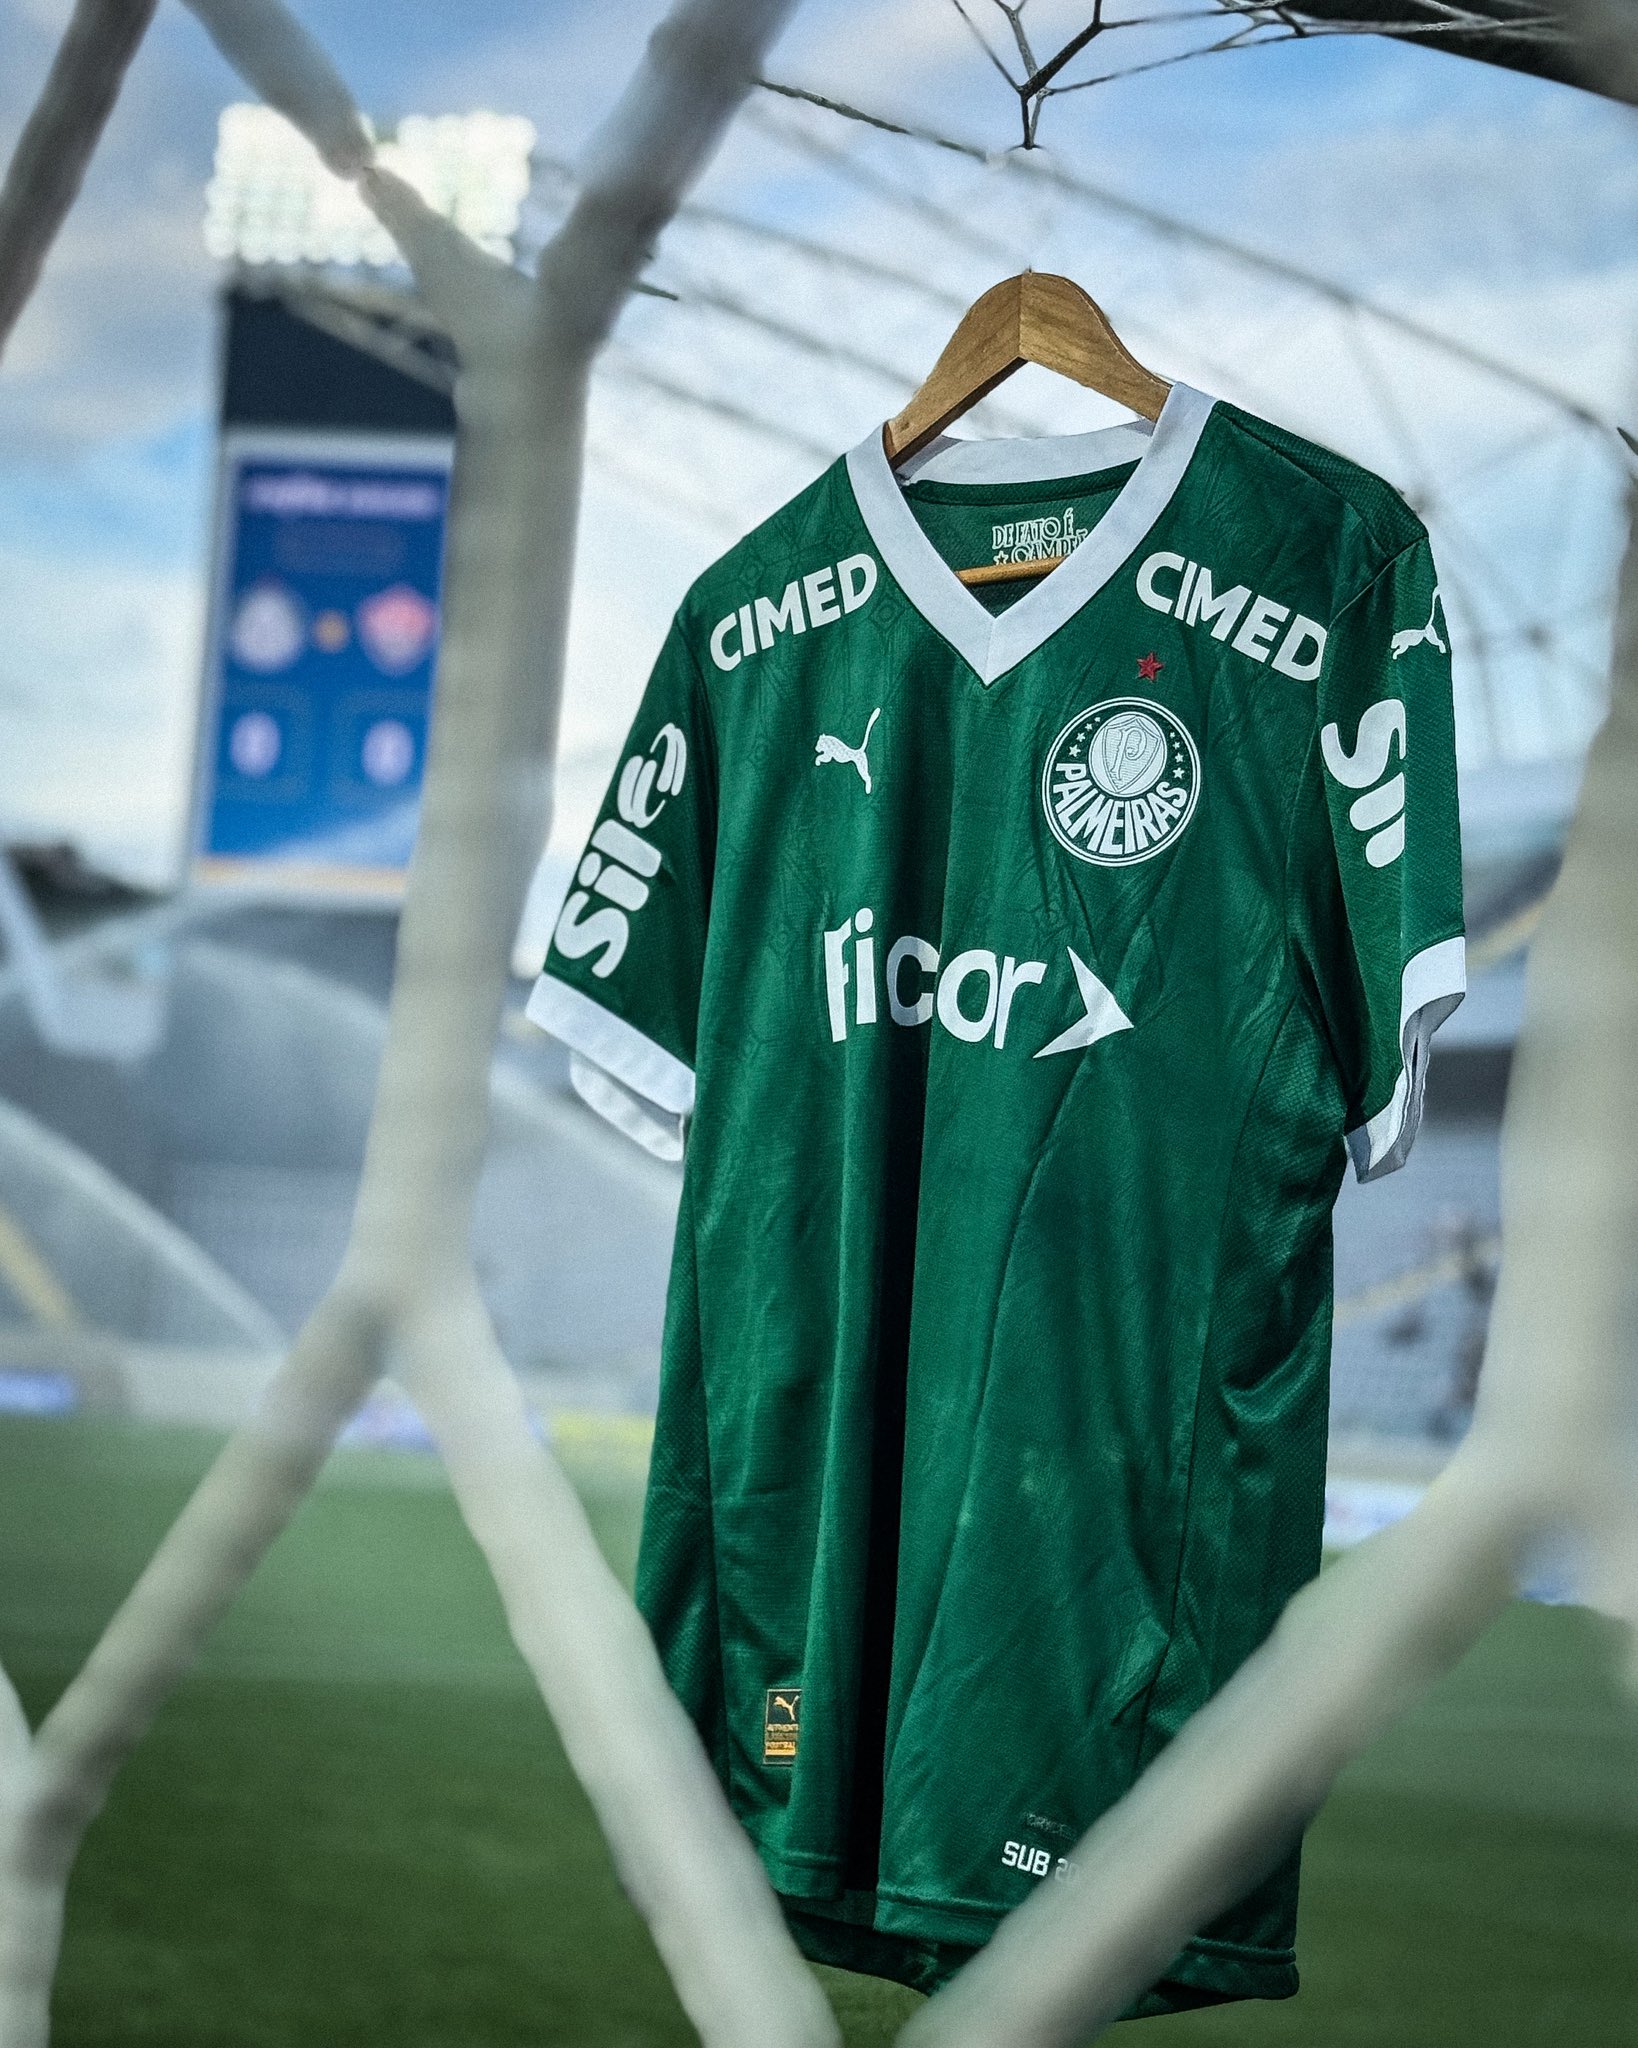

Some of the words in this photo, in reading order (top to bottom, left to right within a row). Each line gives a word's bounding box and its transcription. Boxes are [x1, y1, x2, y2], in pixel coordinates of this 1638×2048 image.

[992, 524, 1014, 549] DE
[1015, 517, 1061, 545] FATO
[1063, 507, 1074, 538] É
[710, 553, 878, 671] CIMED
[1136, 551, 1328, 682] CIMED
[1052, 762, 1188, 855] PALMEIRAS
[1001, 1840, 1051, 1877] SUB
